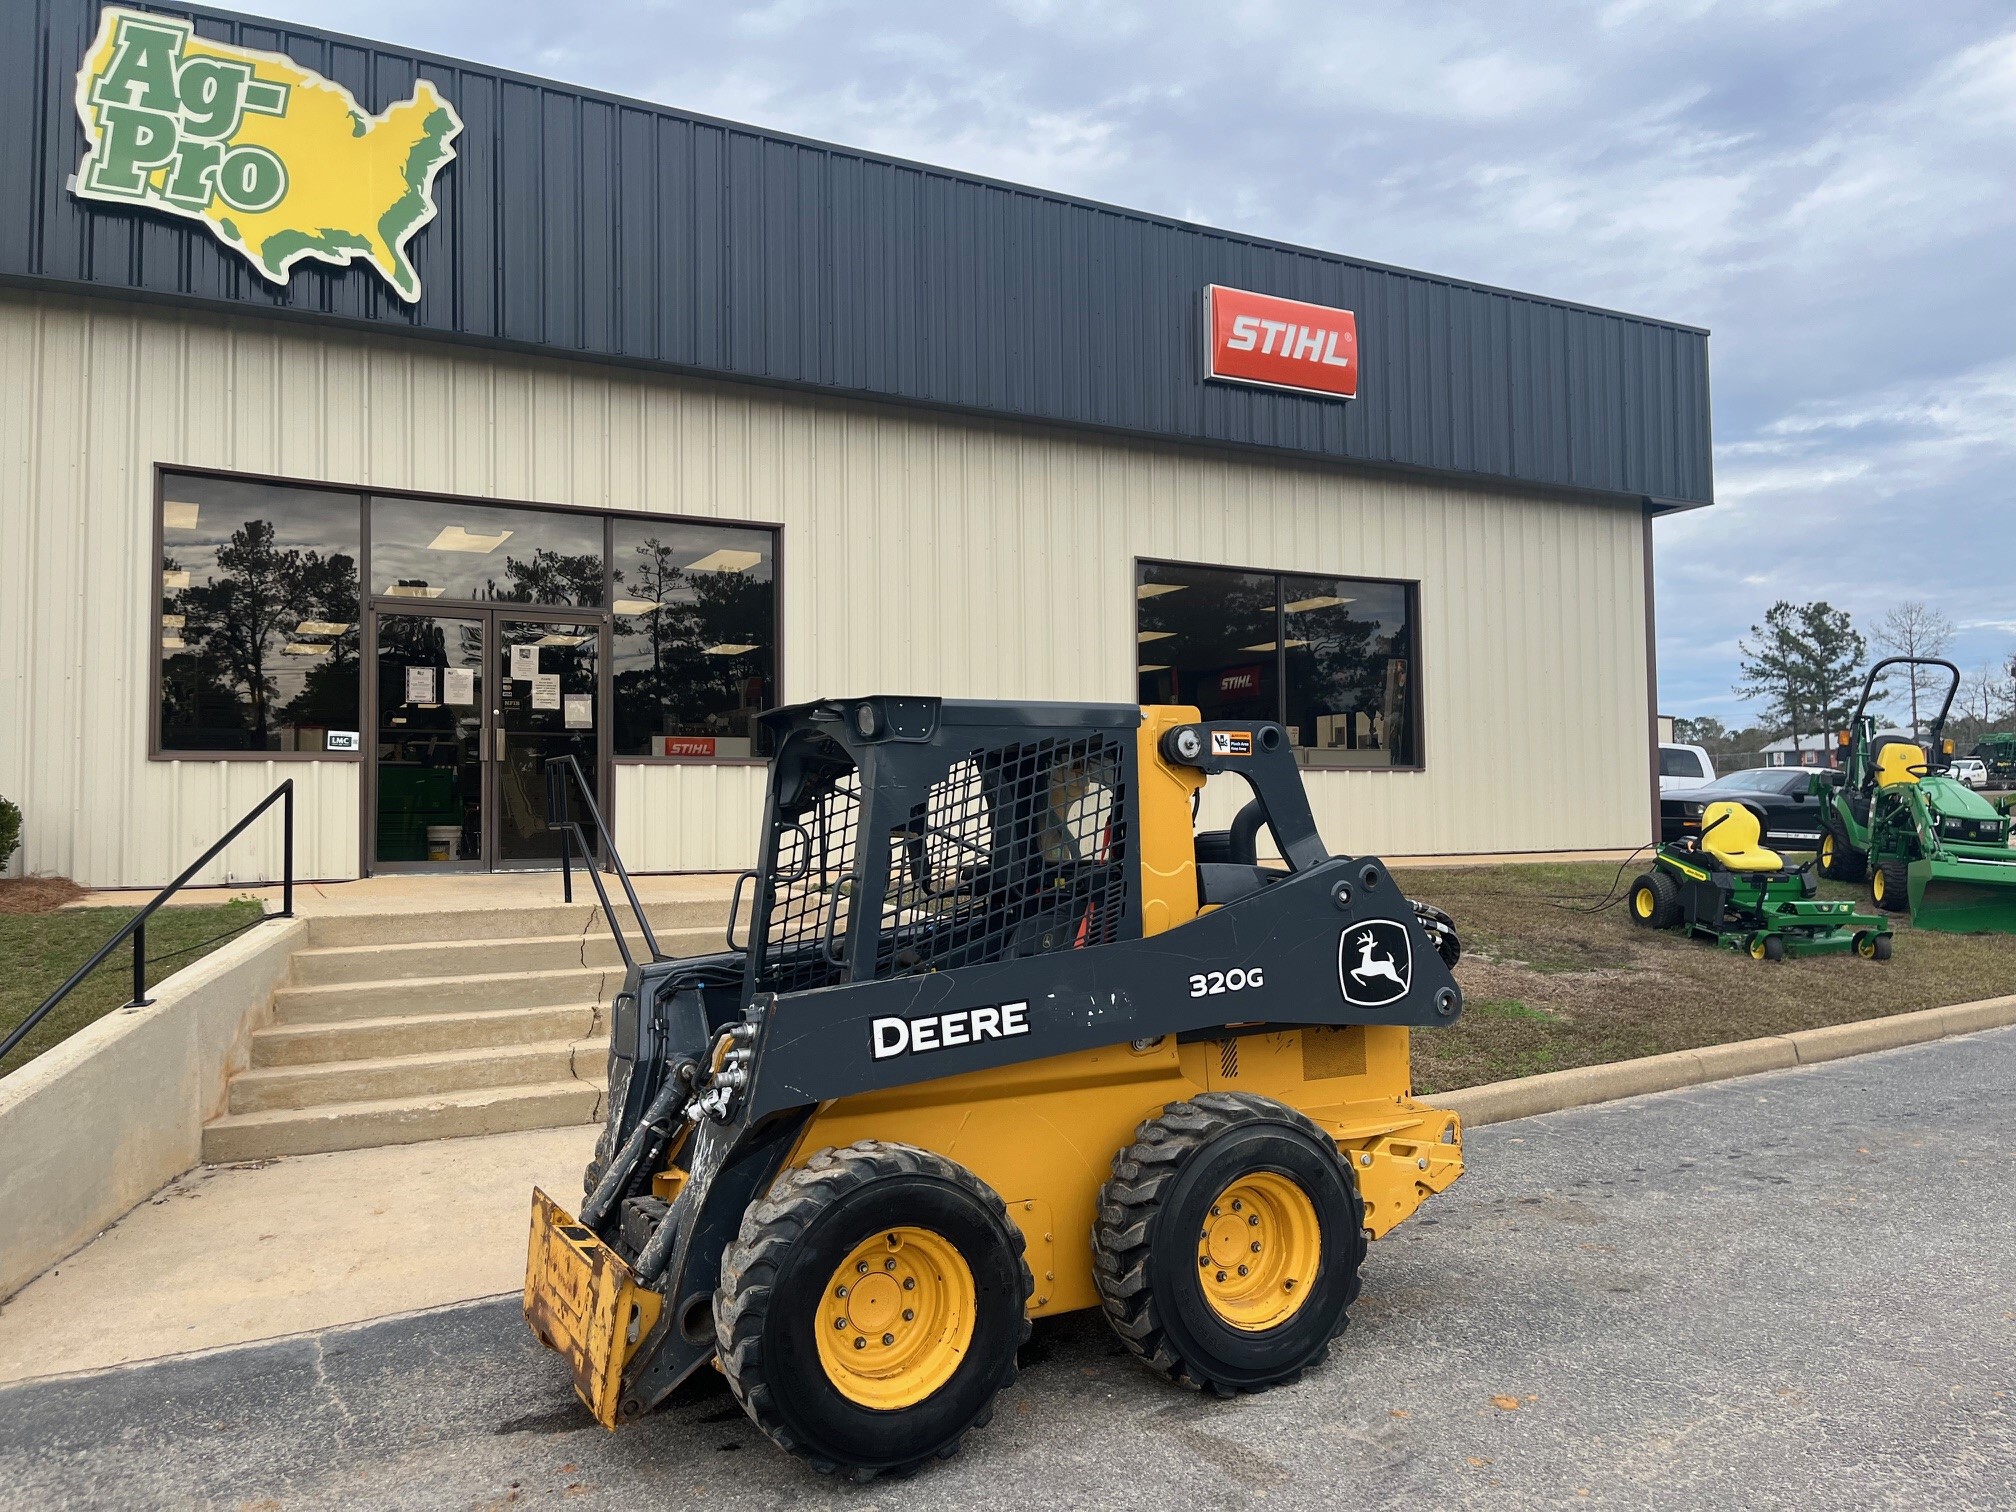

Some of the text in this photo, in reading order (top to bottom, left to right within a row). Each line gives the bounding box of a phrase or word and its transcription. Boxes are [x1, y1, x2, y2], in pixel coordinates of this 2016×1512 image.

[92, 19, 287, 142] Ag-
[90, 104, 286, 212] Pro
[1226, 314, 1349, 368] STIHL
[1221, 674, 1253, 690] STIHL
[331, 736, 350, 744] LMC
[670, 743, 711, 755] STIHL
[1189, 967, 1264, 998] 320G
[872, 1001, 1030, 1059] DEERE
